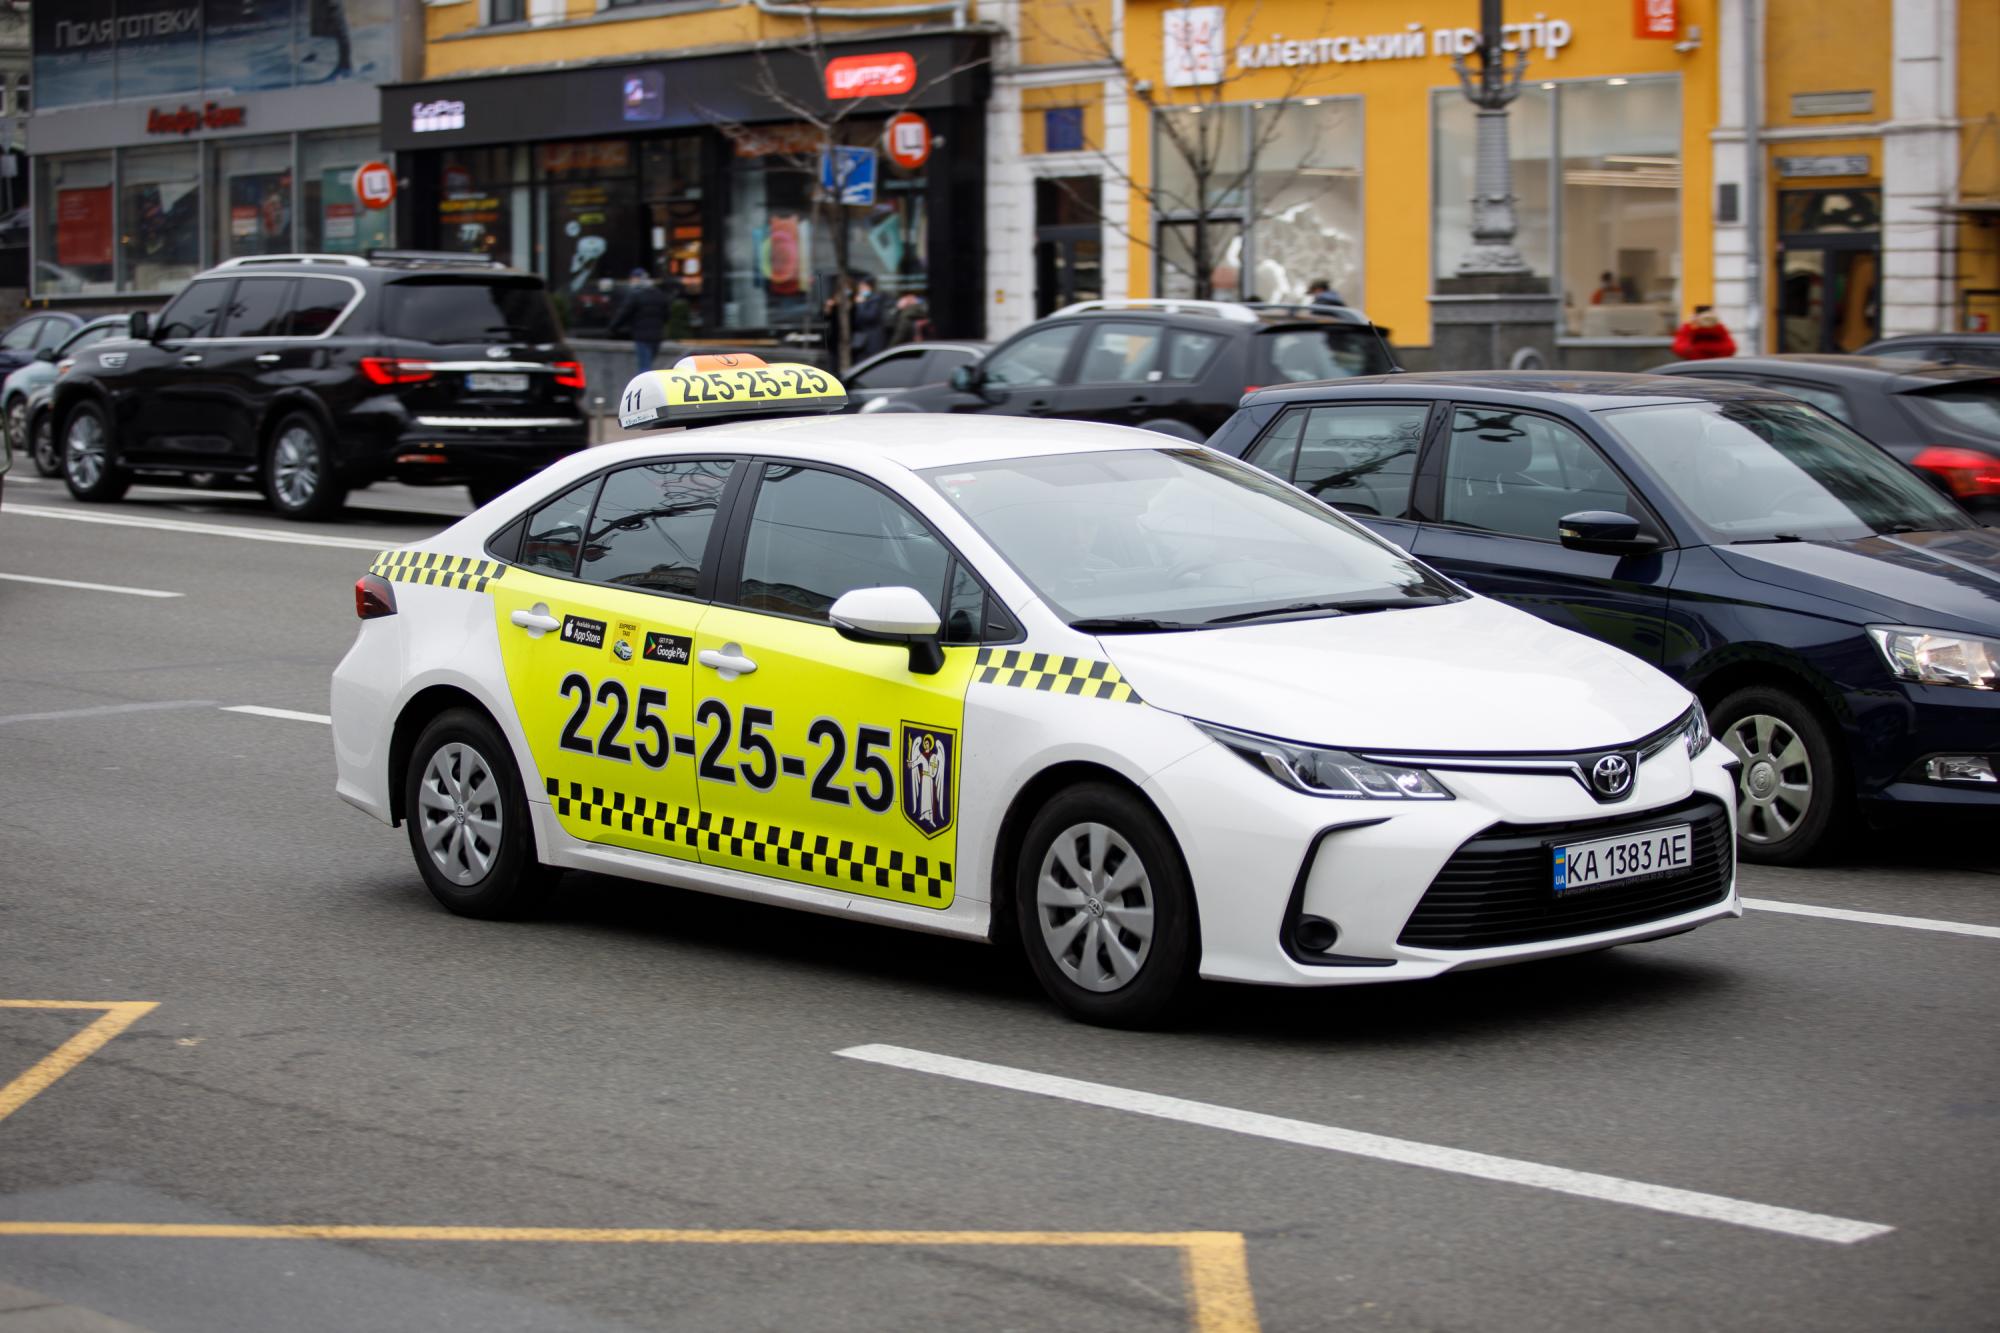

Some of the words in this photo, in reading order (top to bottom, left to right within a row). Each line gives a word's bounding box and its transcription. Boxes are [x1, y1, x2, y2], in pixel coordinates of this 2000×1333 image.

[1237, 22, 1426, 68] клієнтський
[625, 388, 642, 412] 11
[671, 368, 829, 403] 225-25-25
[573, 629, 586, 643] App
[586, 630, 601, 644] Store
[657, 645, 676, 659] Google
[676, 648, 688, 661] Play
[559, 671, 896, 814] 225-25-25
[1568, 850, 1599, 884] KA
[1605, 839, 1652, 876] 1383
[1658, 834, 1687, 868] AE
[1555, 875, 1565, 885] UA
